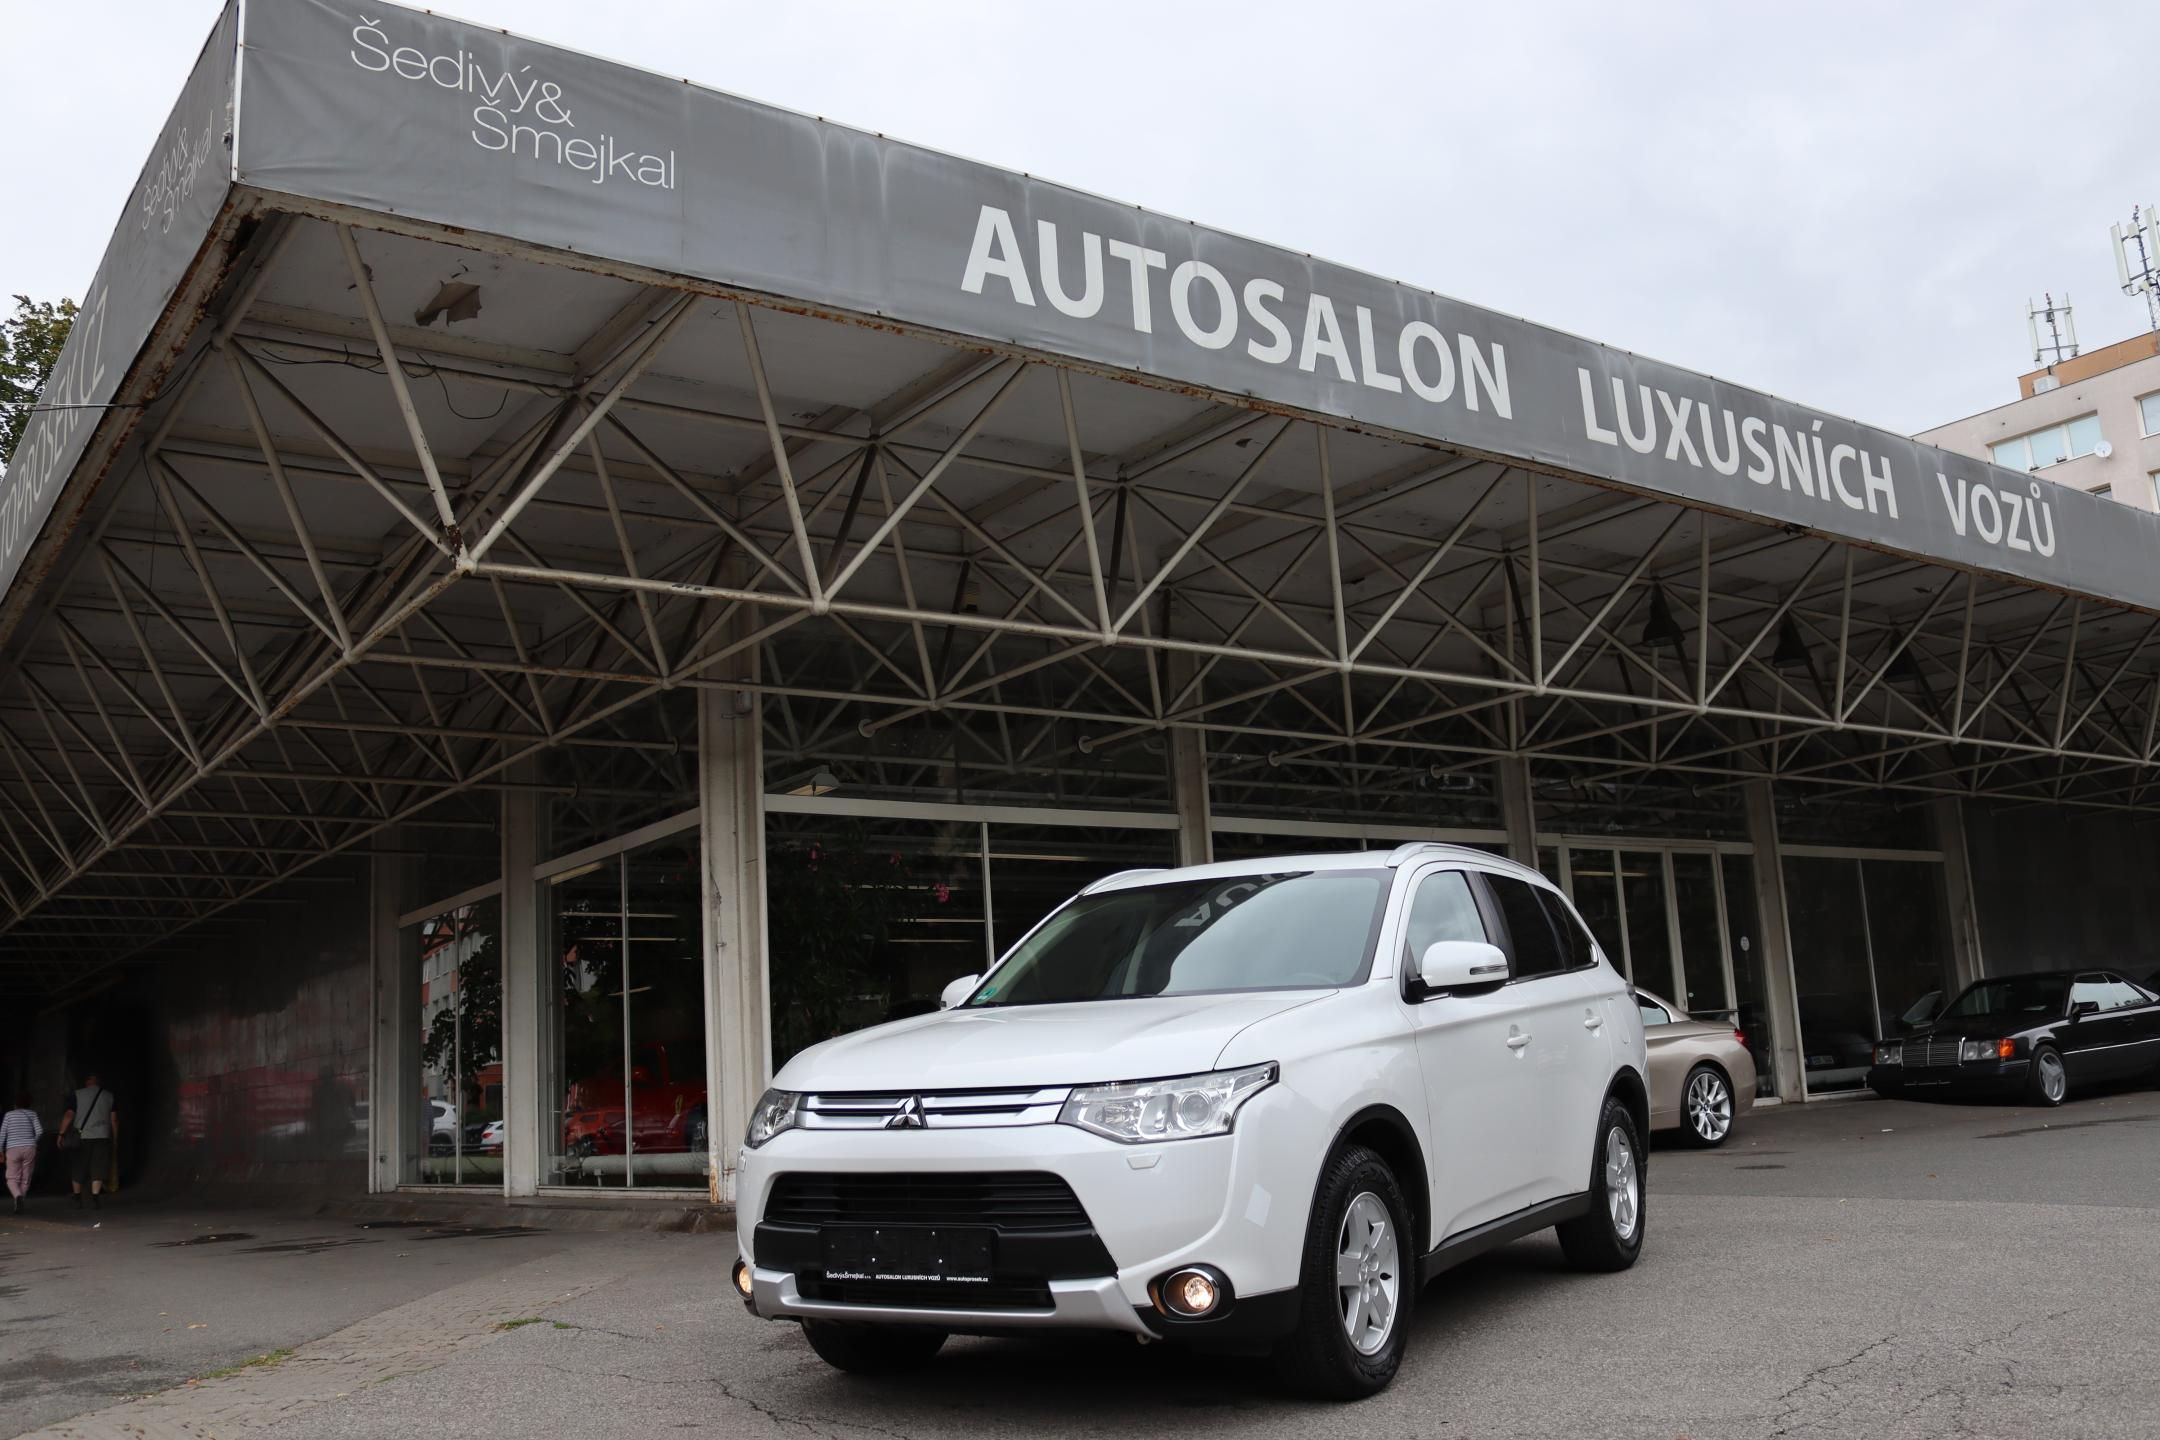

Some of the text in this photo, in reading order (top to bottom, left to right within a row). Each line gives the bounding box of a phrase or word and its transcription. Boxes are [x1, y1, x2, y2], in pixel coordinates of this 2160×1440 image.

[351, 15, 575, 128] Šedivý&
[472, 95, 675, 189] Šmejkal
[961, 204, 2056, 557] AUTOSALON LUXUSNÍCH VOZŮ
